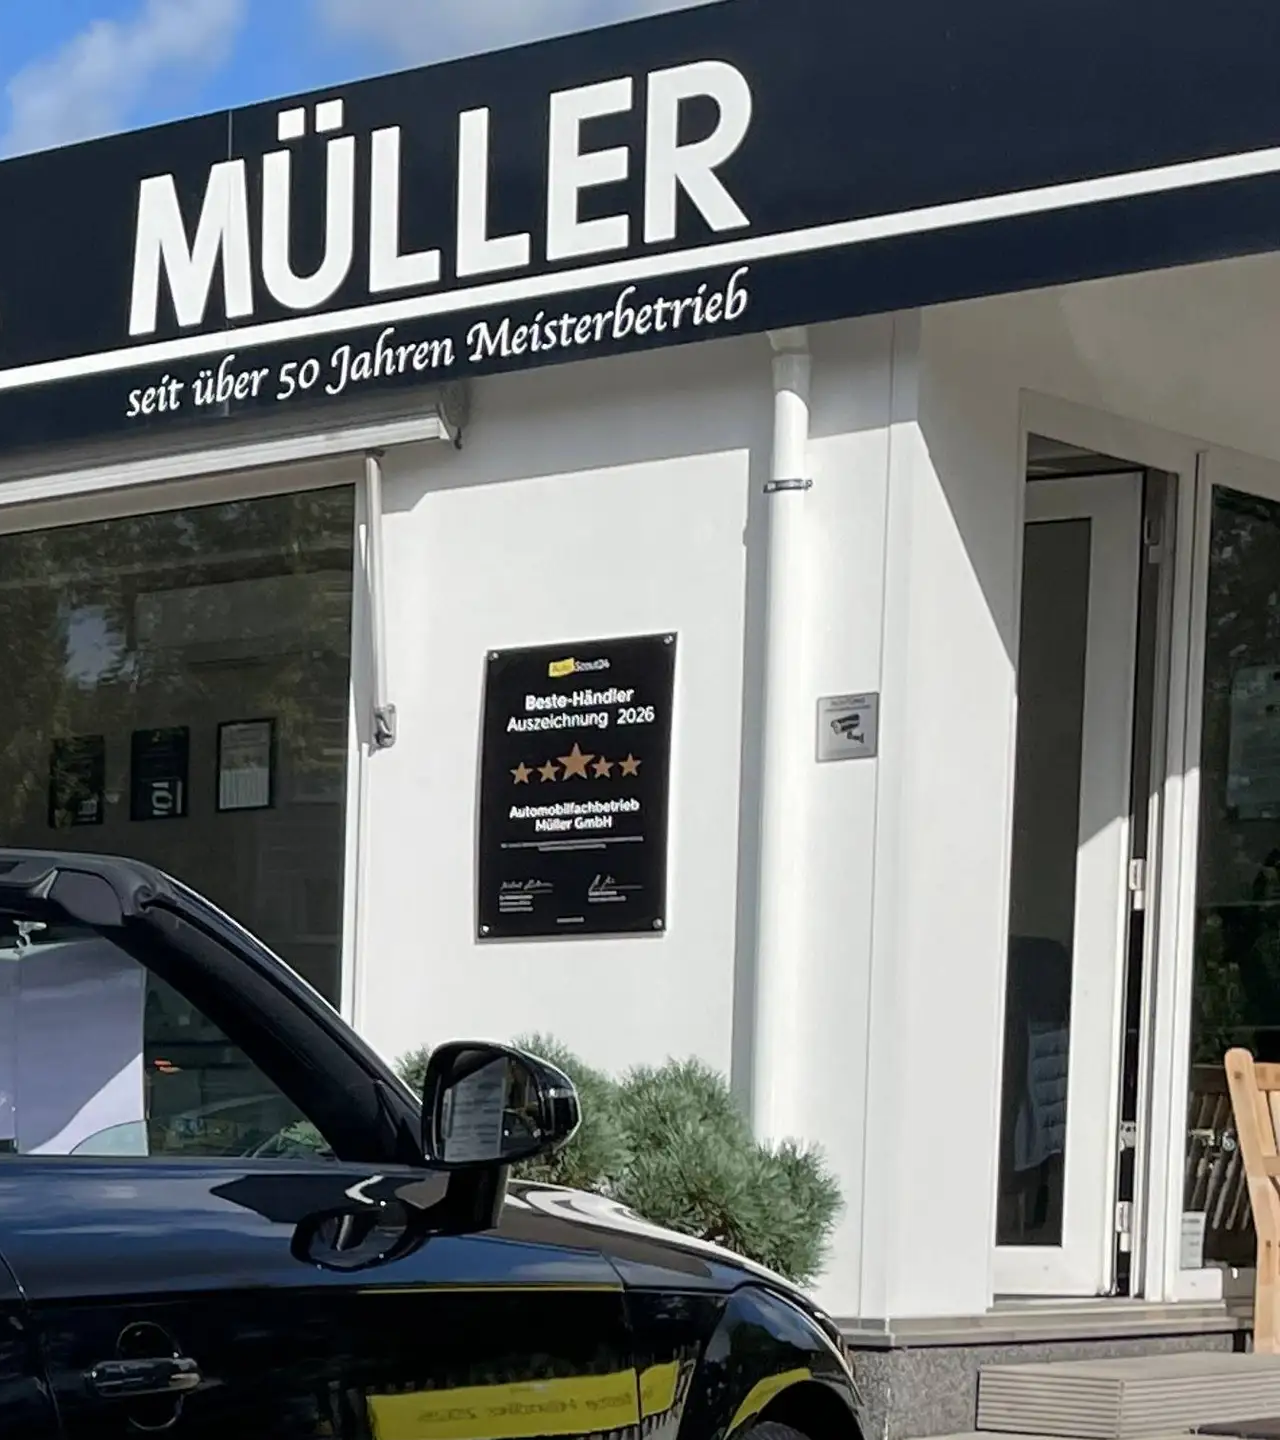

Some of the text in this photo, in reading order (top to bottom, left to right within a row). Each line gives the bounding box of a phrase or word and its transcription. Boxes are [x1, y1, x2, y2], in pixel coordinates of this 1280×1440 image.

[128, 60, 752, 335] MÜLLER
[126, 267, 748, 418] seit über 50 Jahren Meisterbetrieb
[525, 687, 635, 711] Beste-Händler
[507, 706, 655, 732] Auszeichnung 2026
[509, 798, 640, 819] Automobilfachbetrieb
[535, 815, 613, 832] Müller GmbH
